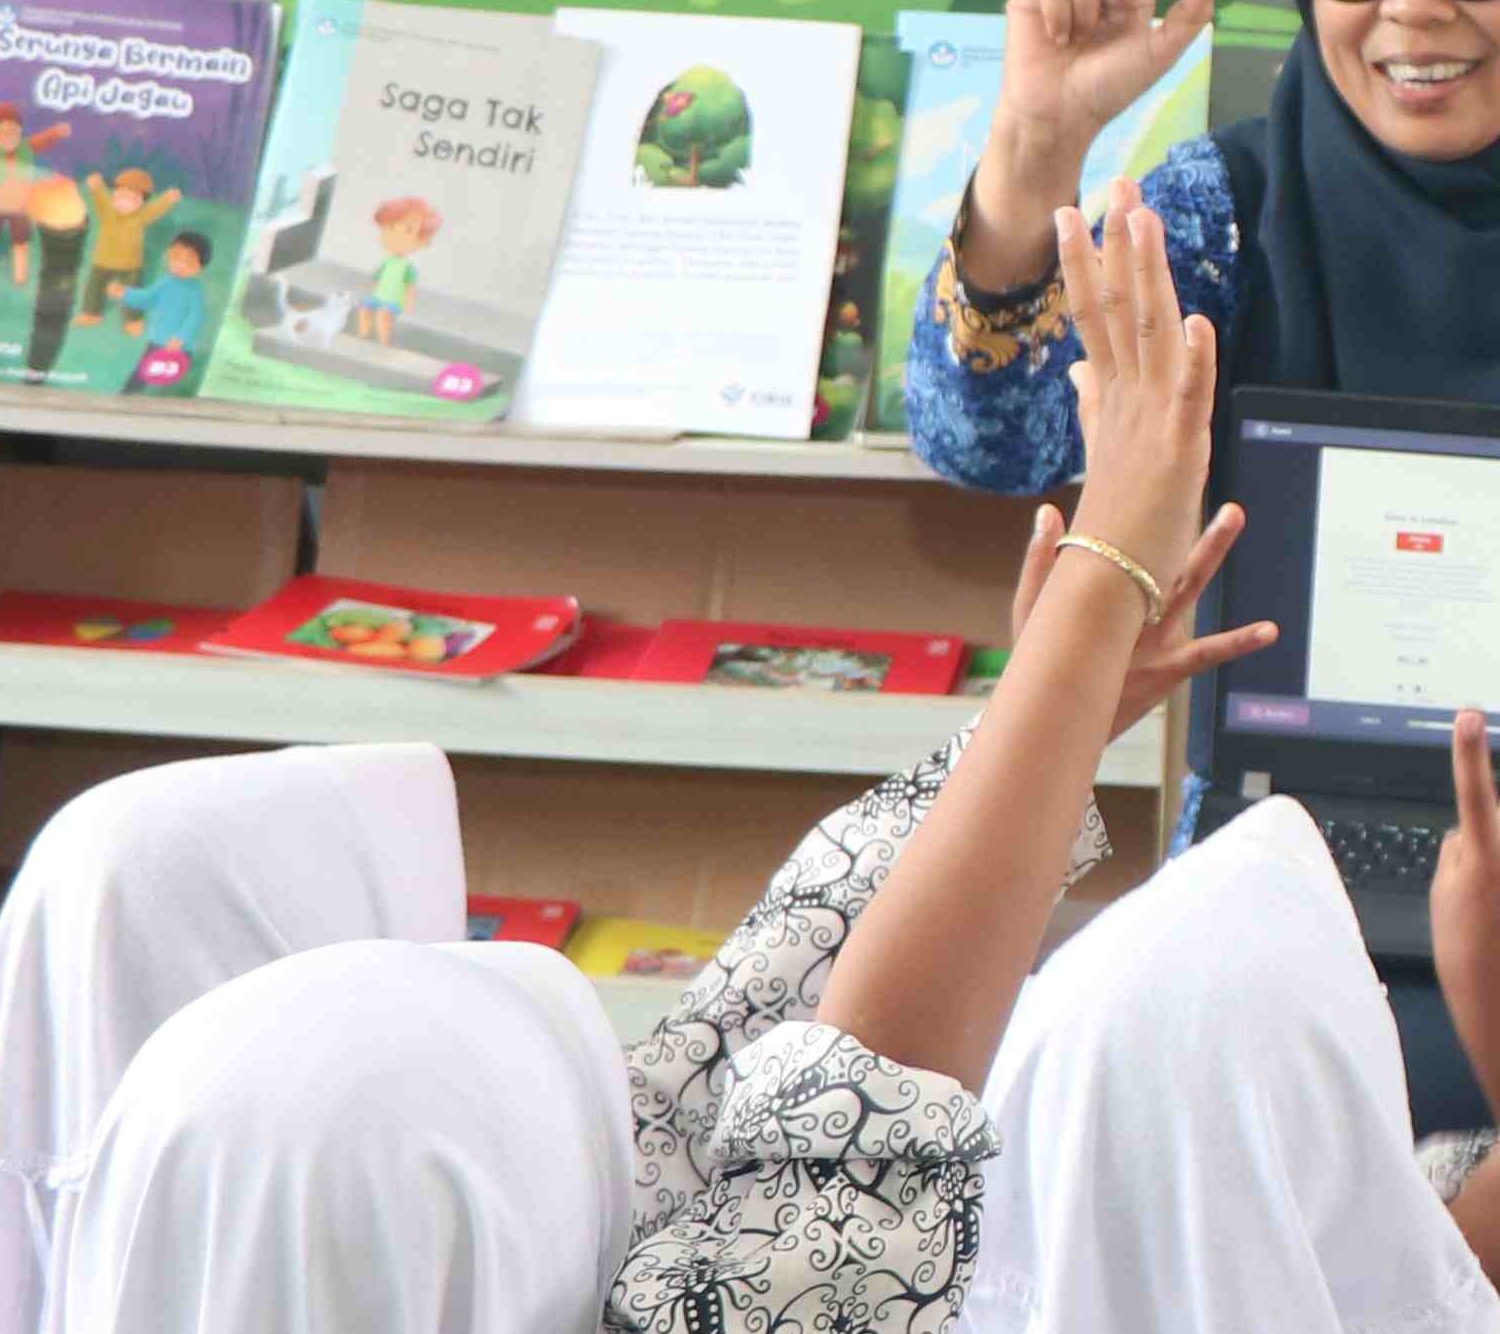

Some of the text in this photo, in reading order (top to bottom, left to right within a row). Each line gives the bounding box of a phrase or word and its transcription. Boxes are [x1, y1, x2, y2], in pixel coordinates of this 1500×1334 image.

[124, 43, 251, 78] Bermain
[40, 72, 94, 110] Api
[380, 82, 544, 135] Saga Tak
[414, 131, 537, 175] Sendiri
